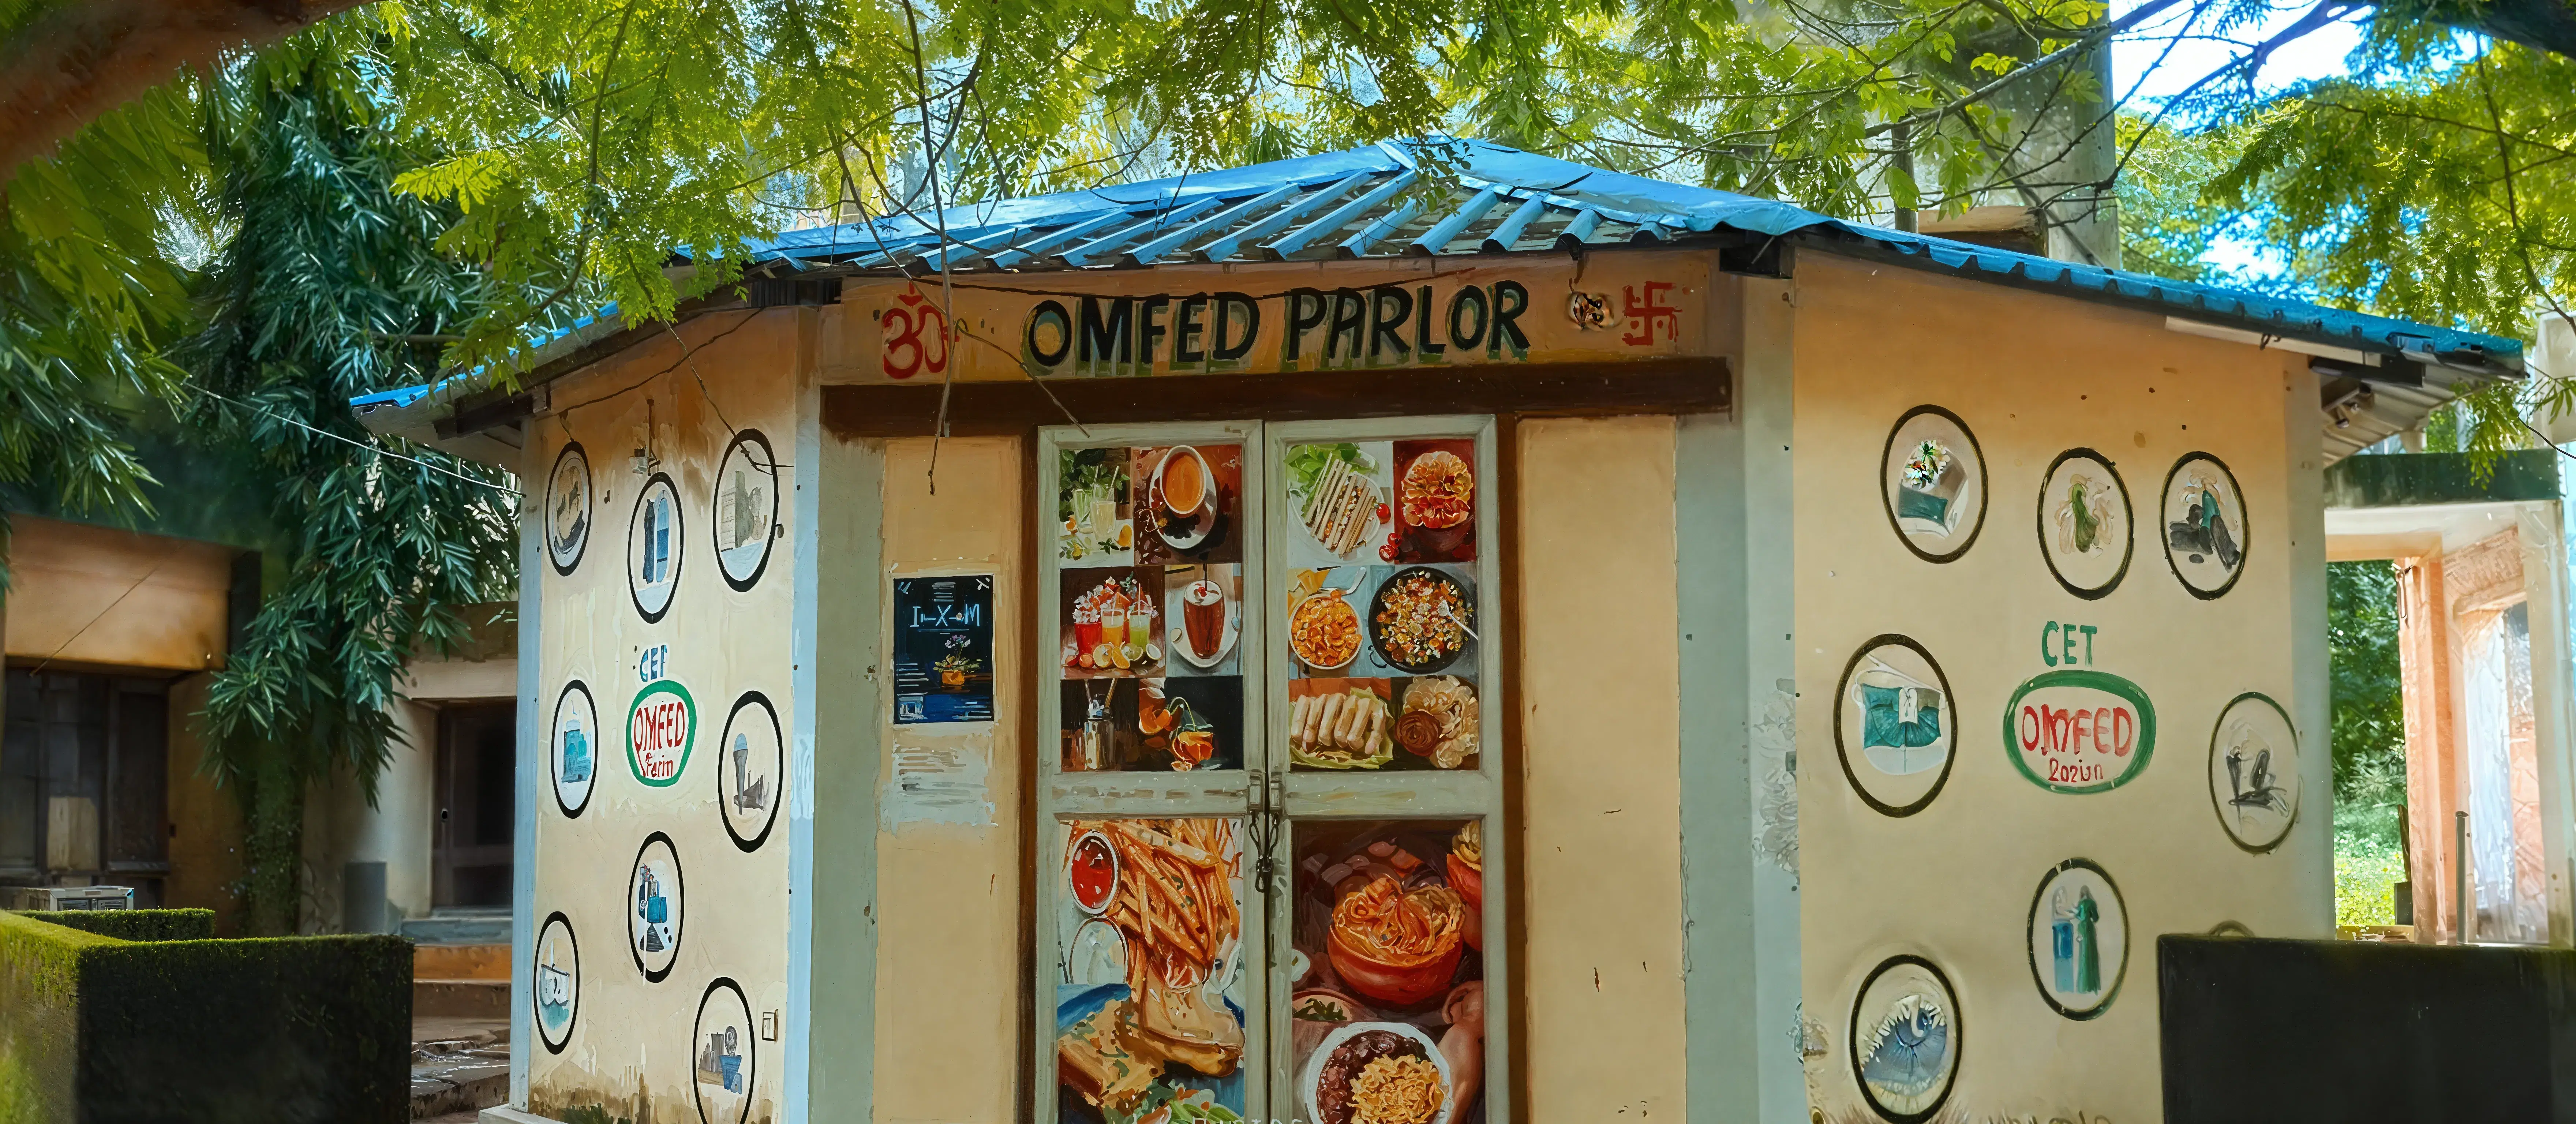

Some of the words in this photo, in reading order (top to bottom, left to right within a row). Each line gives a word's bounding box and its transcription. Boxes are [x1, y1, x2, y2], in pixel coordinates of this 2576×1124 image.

[1022, 292, 1261, 375] OMFED
[1281, 280, 1531, 371] PARLOR
[2042, 621, 2097, 667] CET
[634, 701, 685, 752] OMFED
[2022, 704, 2132, 757] OMFED
